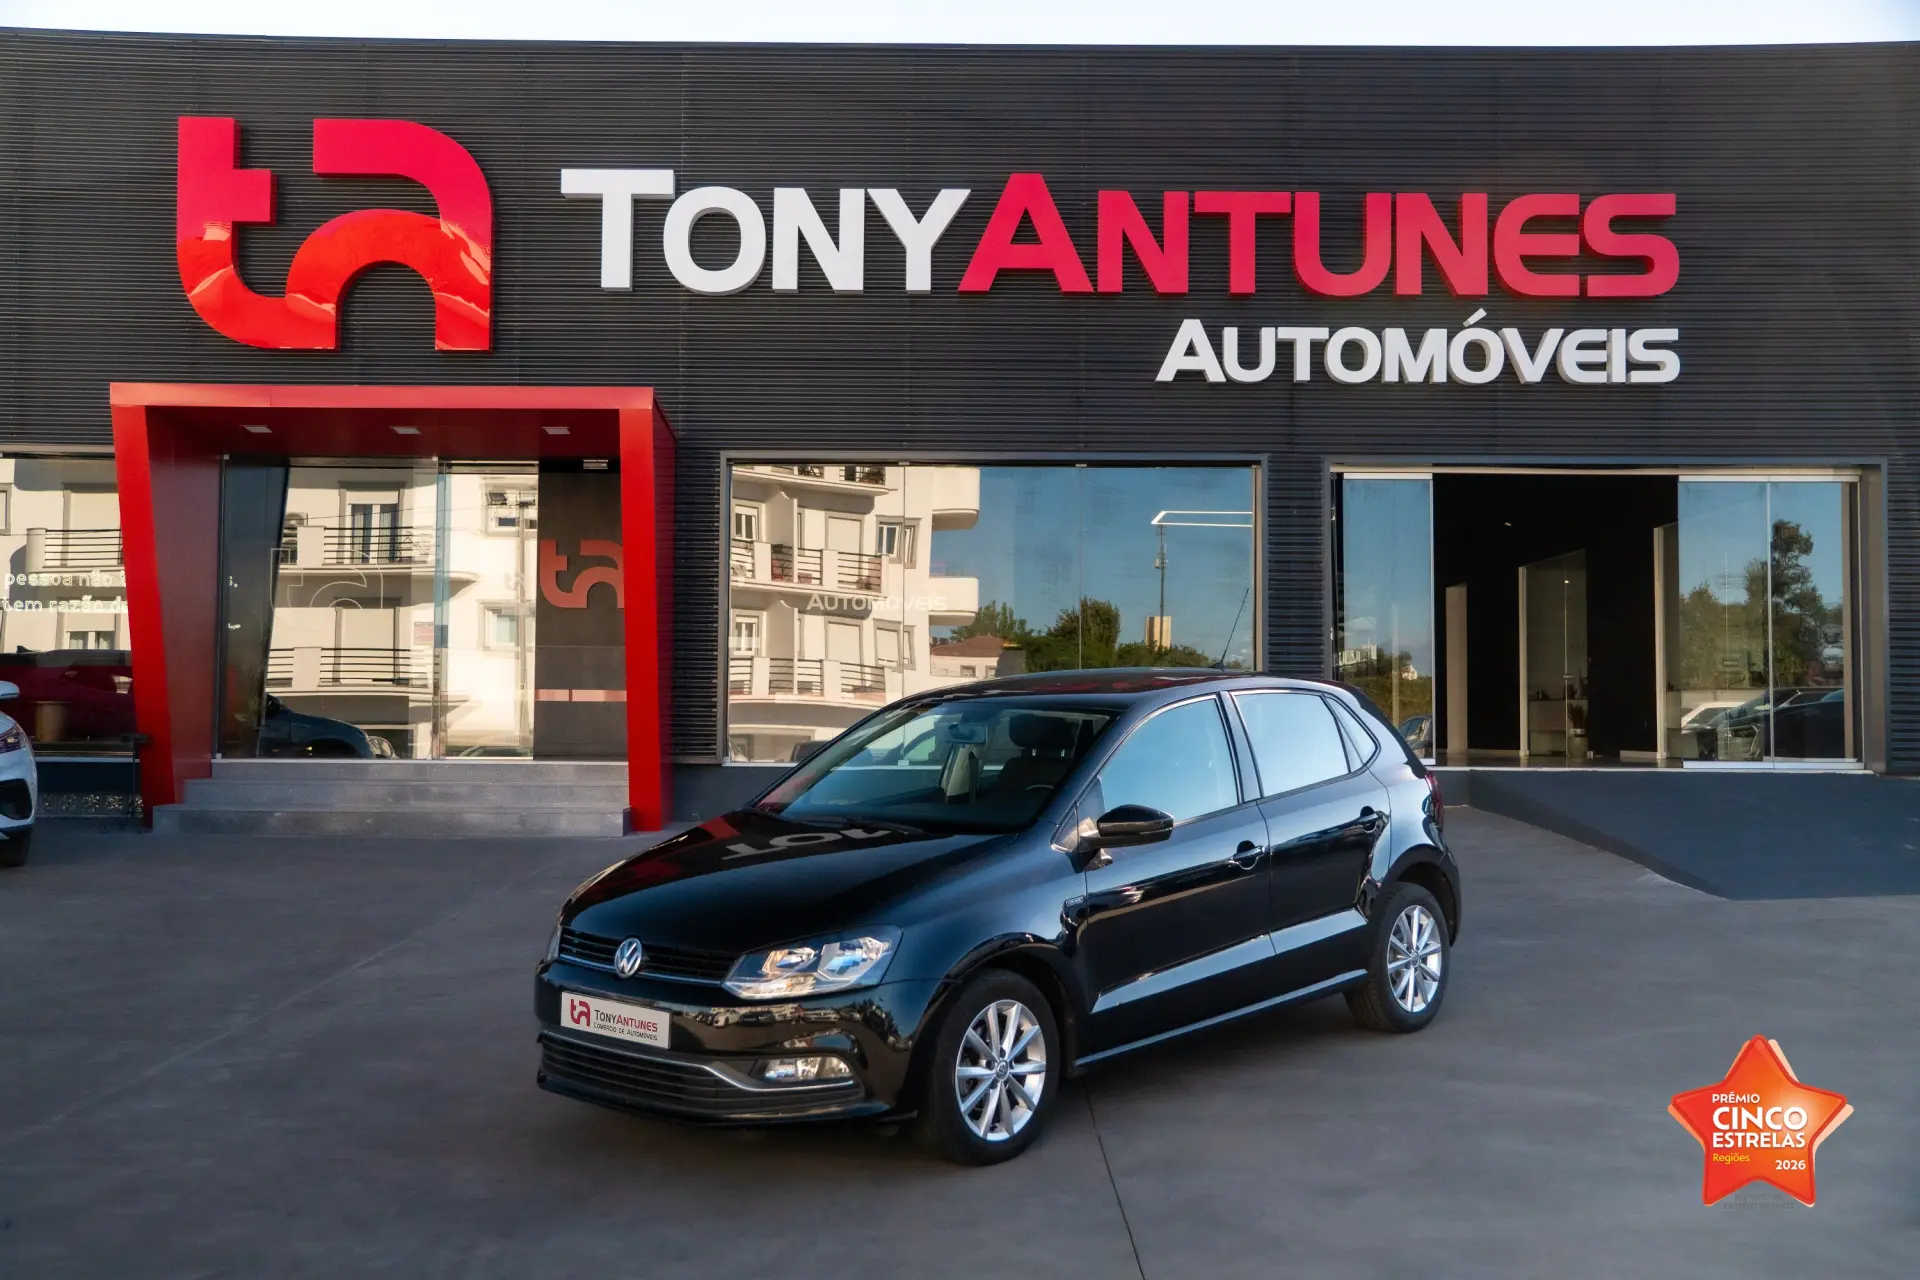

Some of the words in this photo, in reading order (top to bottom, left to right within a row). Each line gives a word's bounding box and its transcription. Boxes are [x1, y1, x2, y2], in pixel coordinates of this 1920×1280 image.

[1155, 308, 1680, 386] AUTOMÓVEIS
[4, 573, 73, 590] pessoa
[79, 570, 113, 588] não
[2, 596, 43, 613] tem
[49, 594, 104, 613] razão
